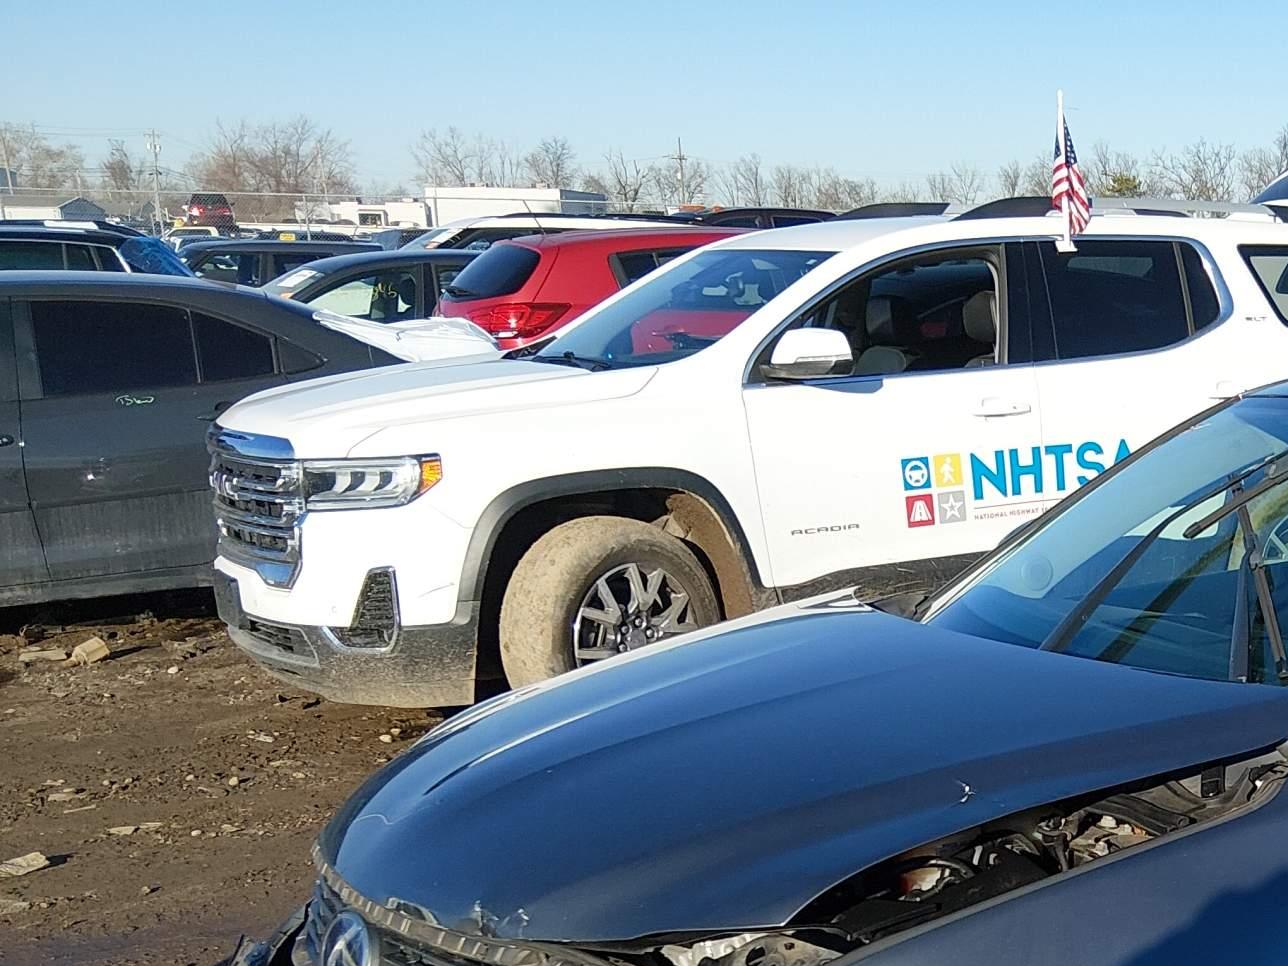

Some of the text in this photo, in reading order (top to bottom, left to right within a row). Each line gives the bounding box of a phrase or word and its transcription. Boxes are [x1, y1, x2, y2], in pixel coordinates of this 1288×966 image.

[974, 511, 1008, 520] NATIONAL
[1009, 507, 1039, 517] HIGHWAY
[790, 523, 860, 536] ACADIA
